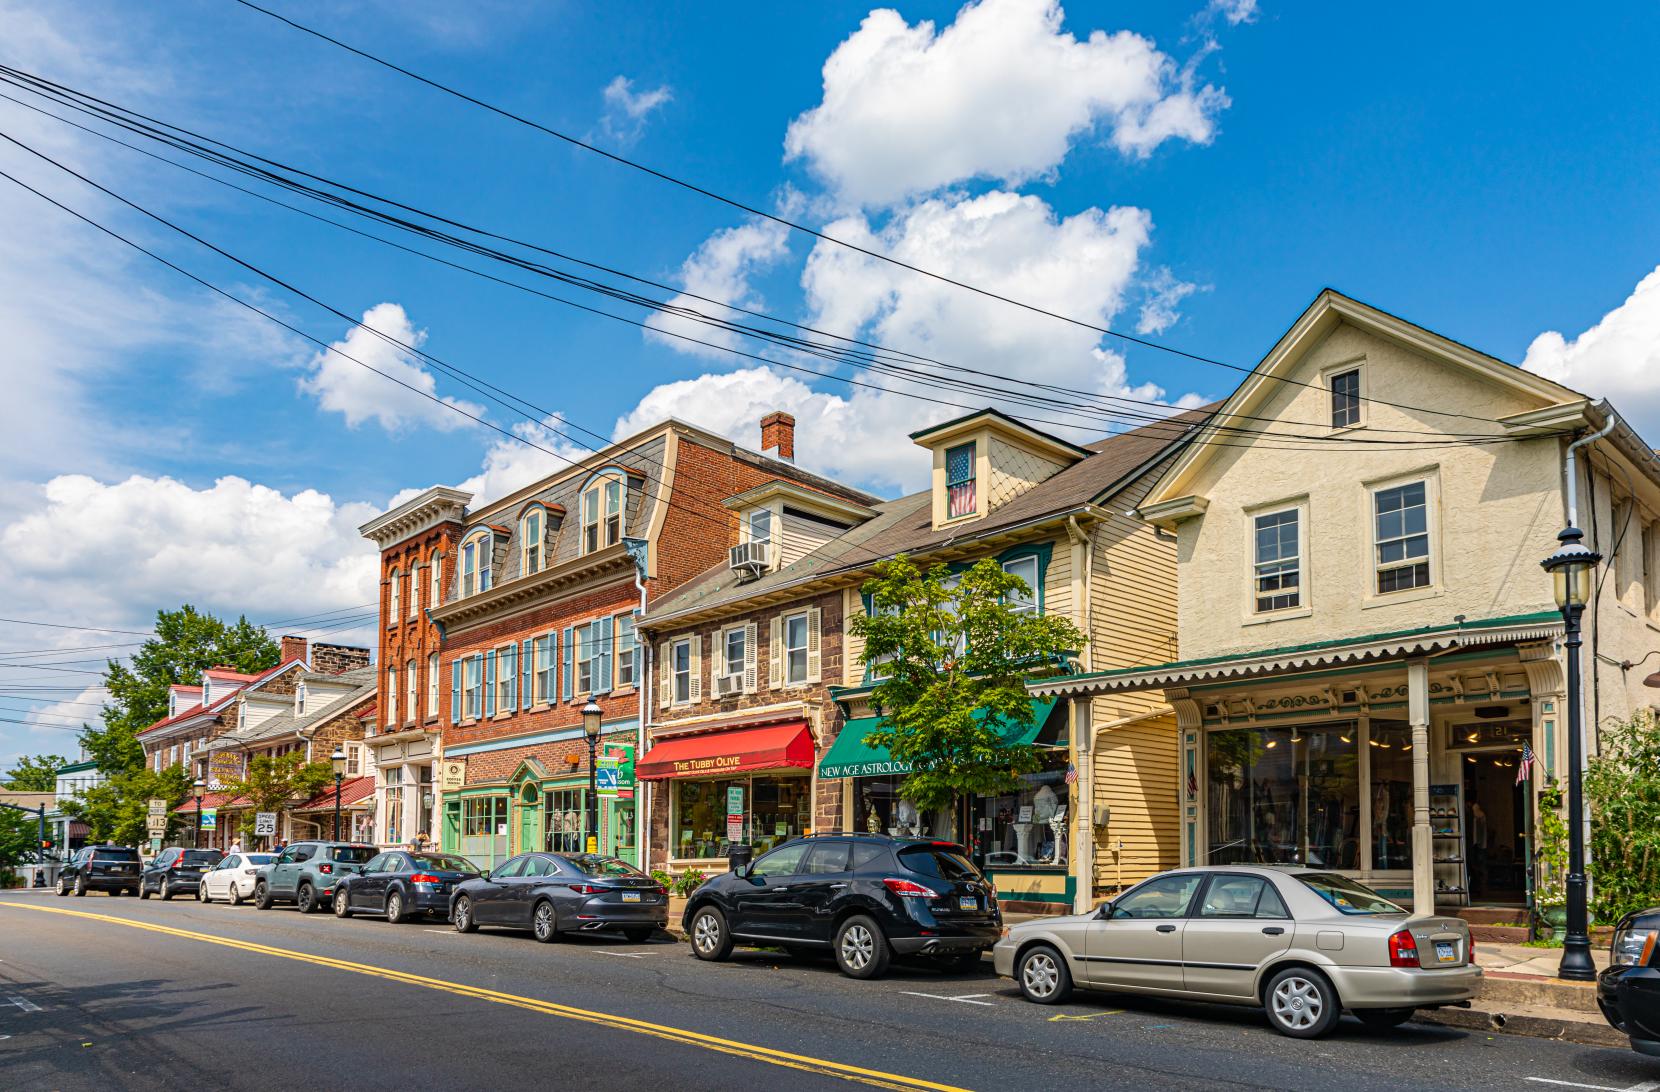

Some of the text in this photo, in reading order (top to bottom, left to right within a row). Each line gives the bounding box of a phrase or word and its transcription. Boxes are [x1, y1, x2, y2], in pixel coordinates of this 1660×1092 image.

[1495, 727, 1507, 736] 21
[673, 756, 740, 771] THE TUBBY OLIVE
[821, 760, 914, 777] NEW AGE ASTROLOGY
[257, 824, 274, 833] 25
